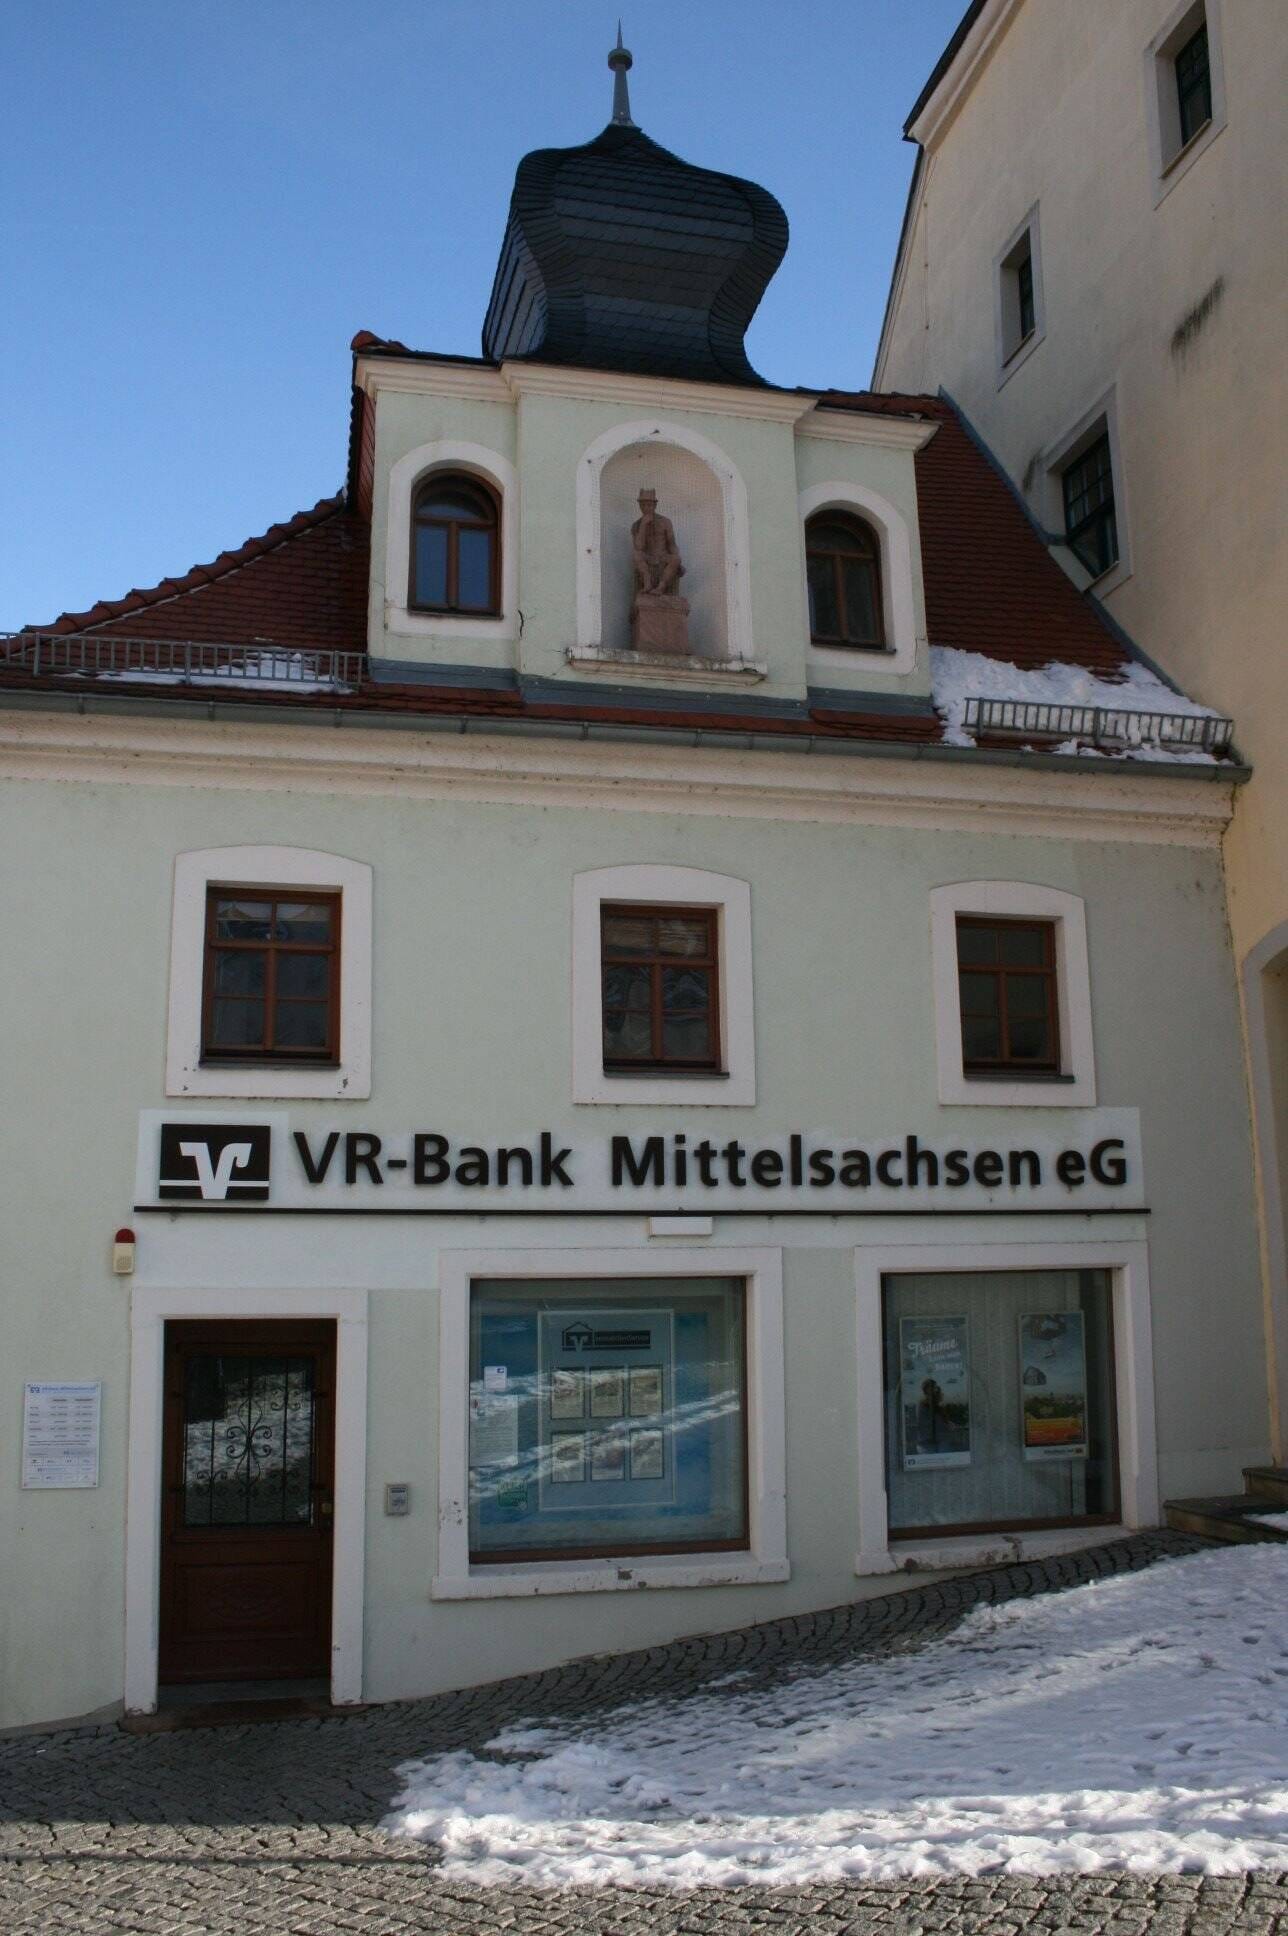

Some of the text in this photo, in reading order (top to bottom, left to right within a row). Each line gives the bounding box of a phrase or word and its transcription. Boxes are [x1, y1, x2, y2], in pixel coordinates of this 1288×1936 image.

[292, 1131, 1129, 1192] VR-Bank Mittelsachsen eG
